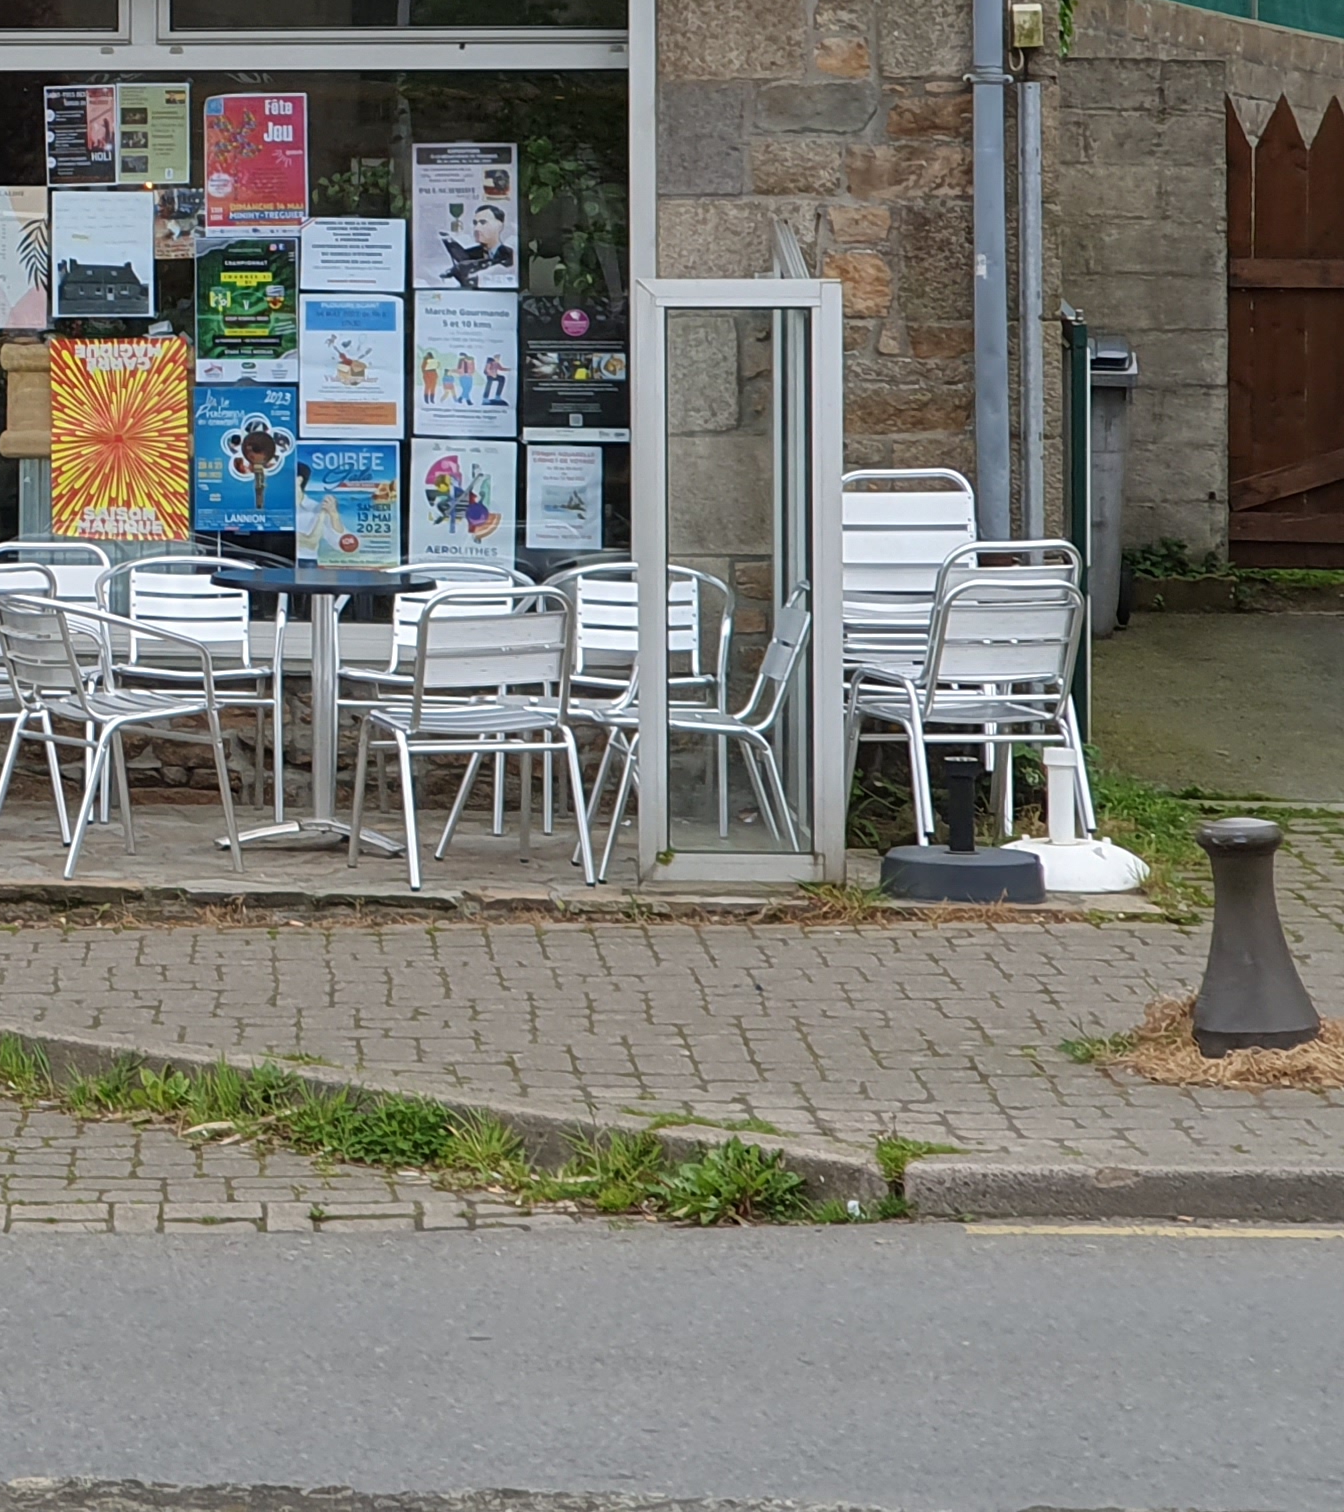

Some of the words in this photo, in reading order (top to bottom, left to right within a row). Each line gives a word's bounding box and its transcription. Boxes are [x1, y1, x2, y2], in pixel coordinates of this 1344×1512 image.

[425, 307, 457, 316] Marche
[459, 308, 510, 318] Gourmande
[450, 320, 459, 328] et
[462, 320, 471, 328] 10
[473, 320, 492, 329] kms
[264, 390, 292, 406] 2023
[311, 448, 385, 471] SOIRÉE
[357, 502, 391, 512] SAMEDI
[83, 506, 156, 521] SAISON
[224, 513, 266, 523] LANNION
[357, 512, 369, 523] 13
[372, 512, 392, 523] MAI
[77, 520, 163, 534] MAGIQUE
[356, 523, 392, 534] 2023
